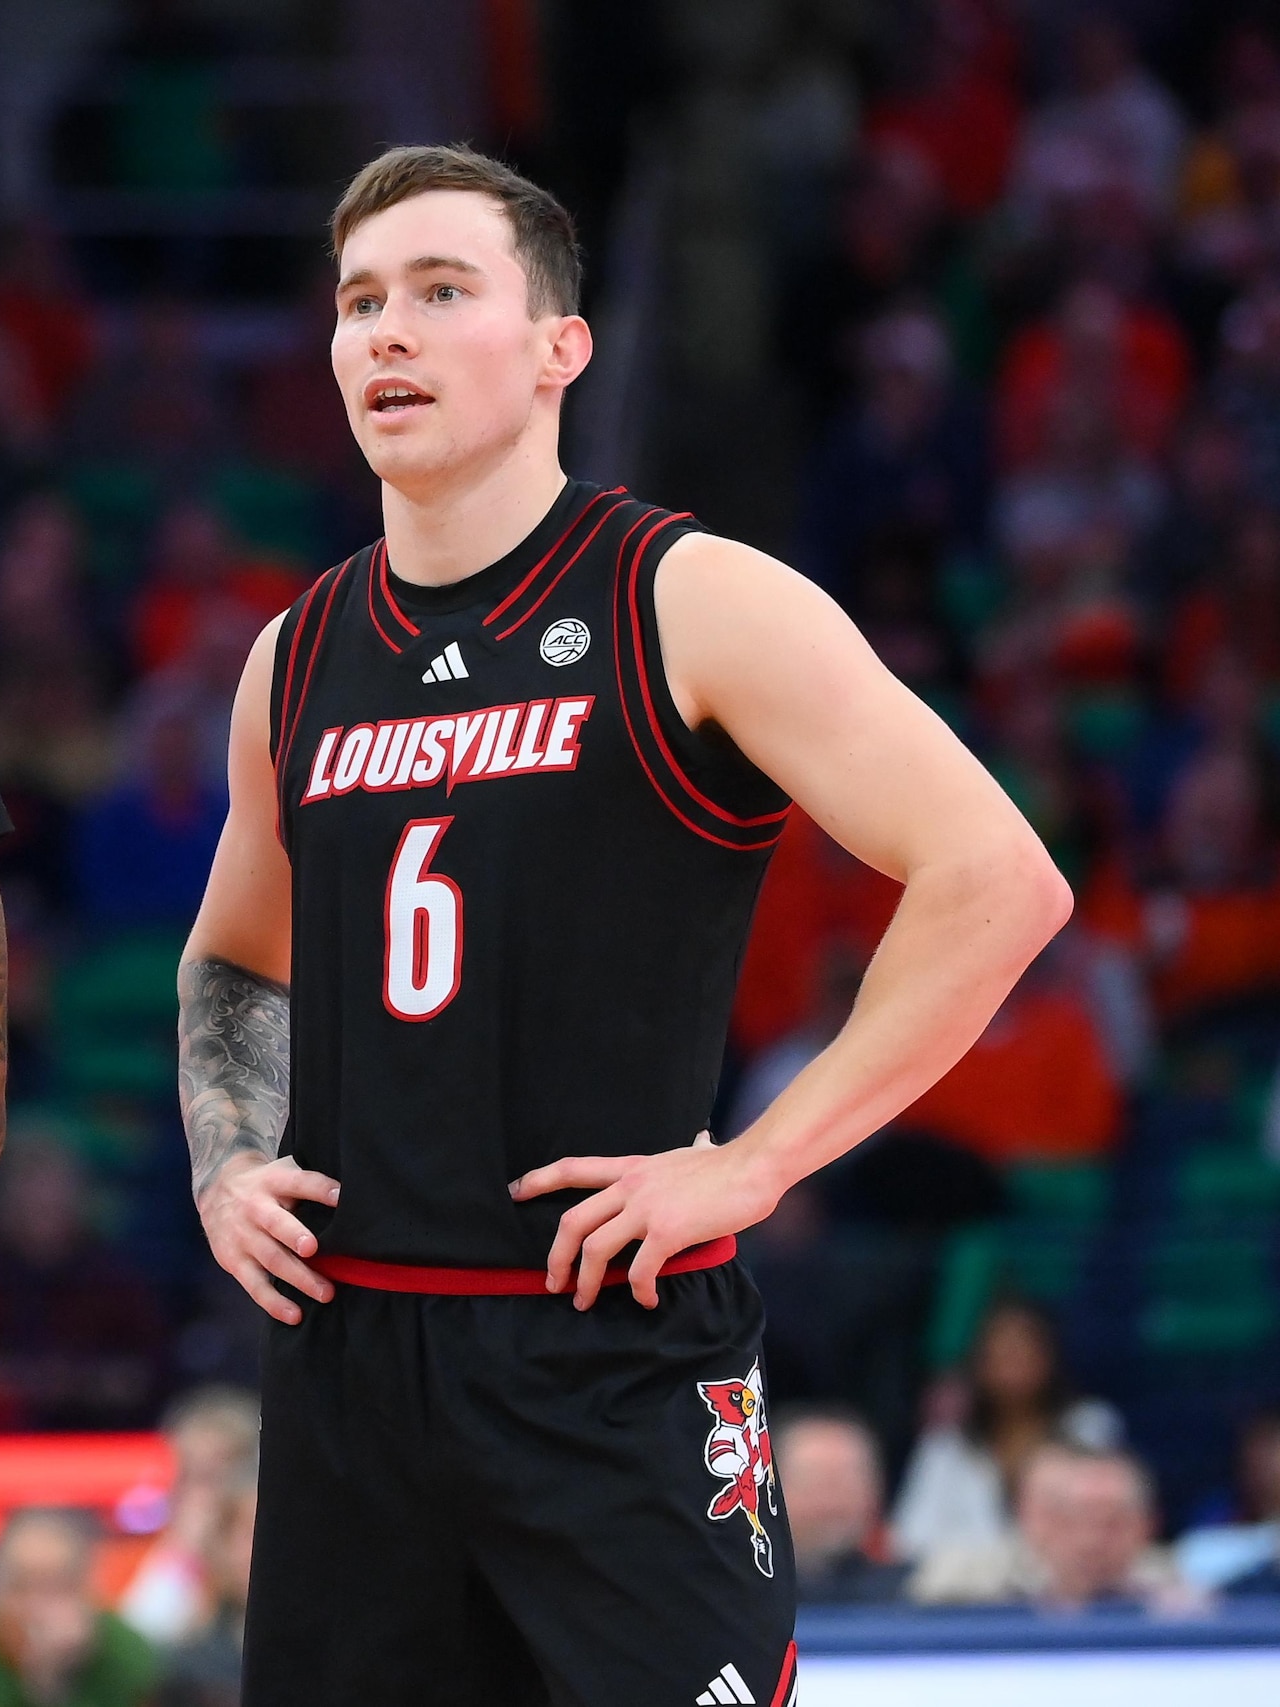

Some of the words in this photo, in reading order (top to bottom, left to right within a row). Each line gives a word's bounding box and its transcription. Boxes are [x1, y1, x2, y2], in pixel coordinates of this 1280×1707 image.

[547, 634, 586, 646] ACC
[299, 694, 596, 807] LOUISVILLE
[381, 814, 464, 1022] 6
